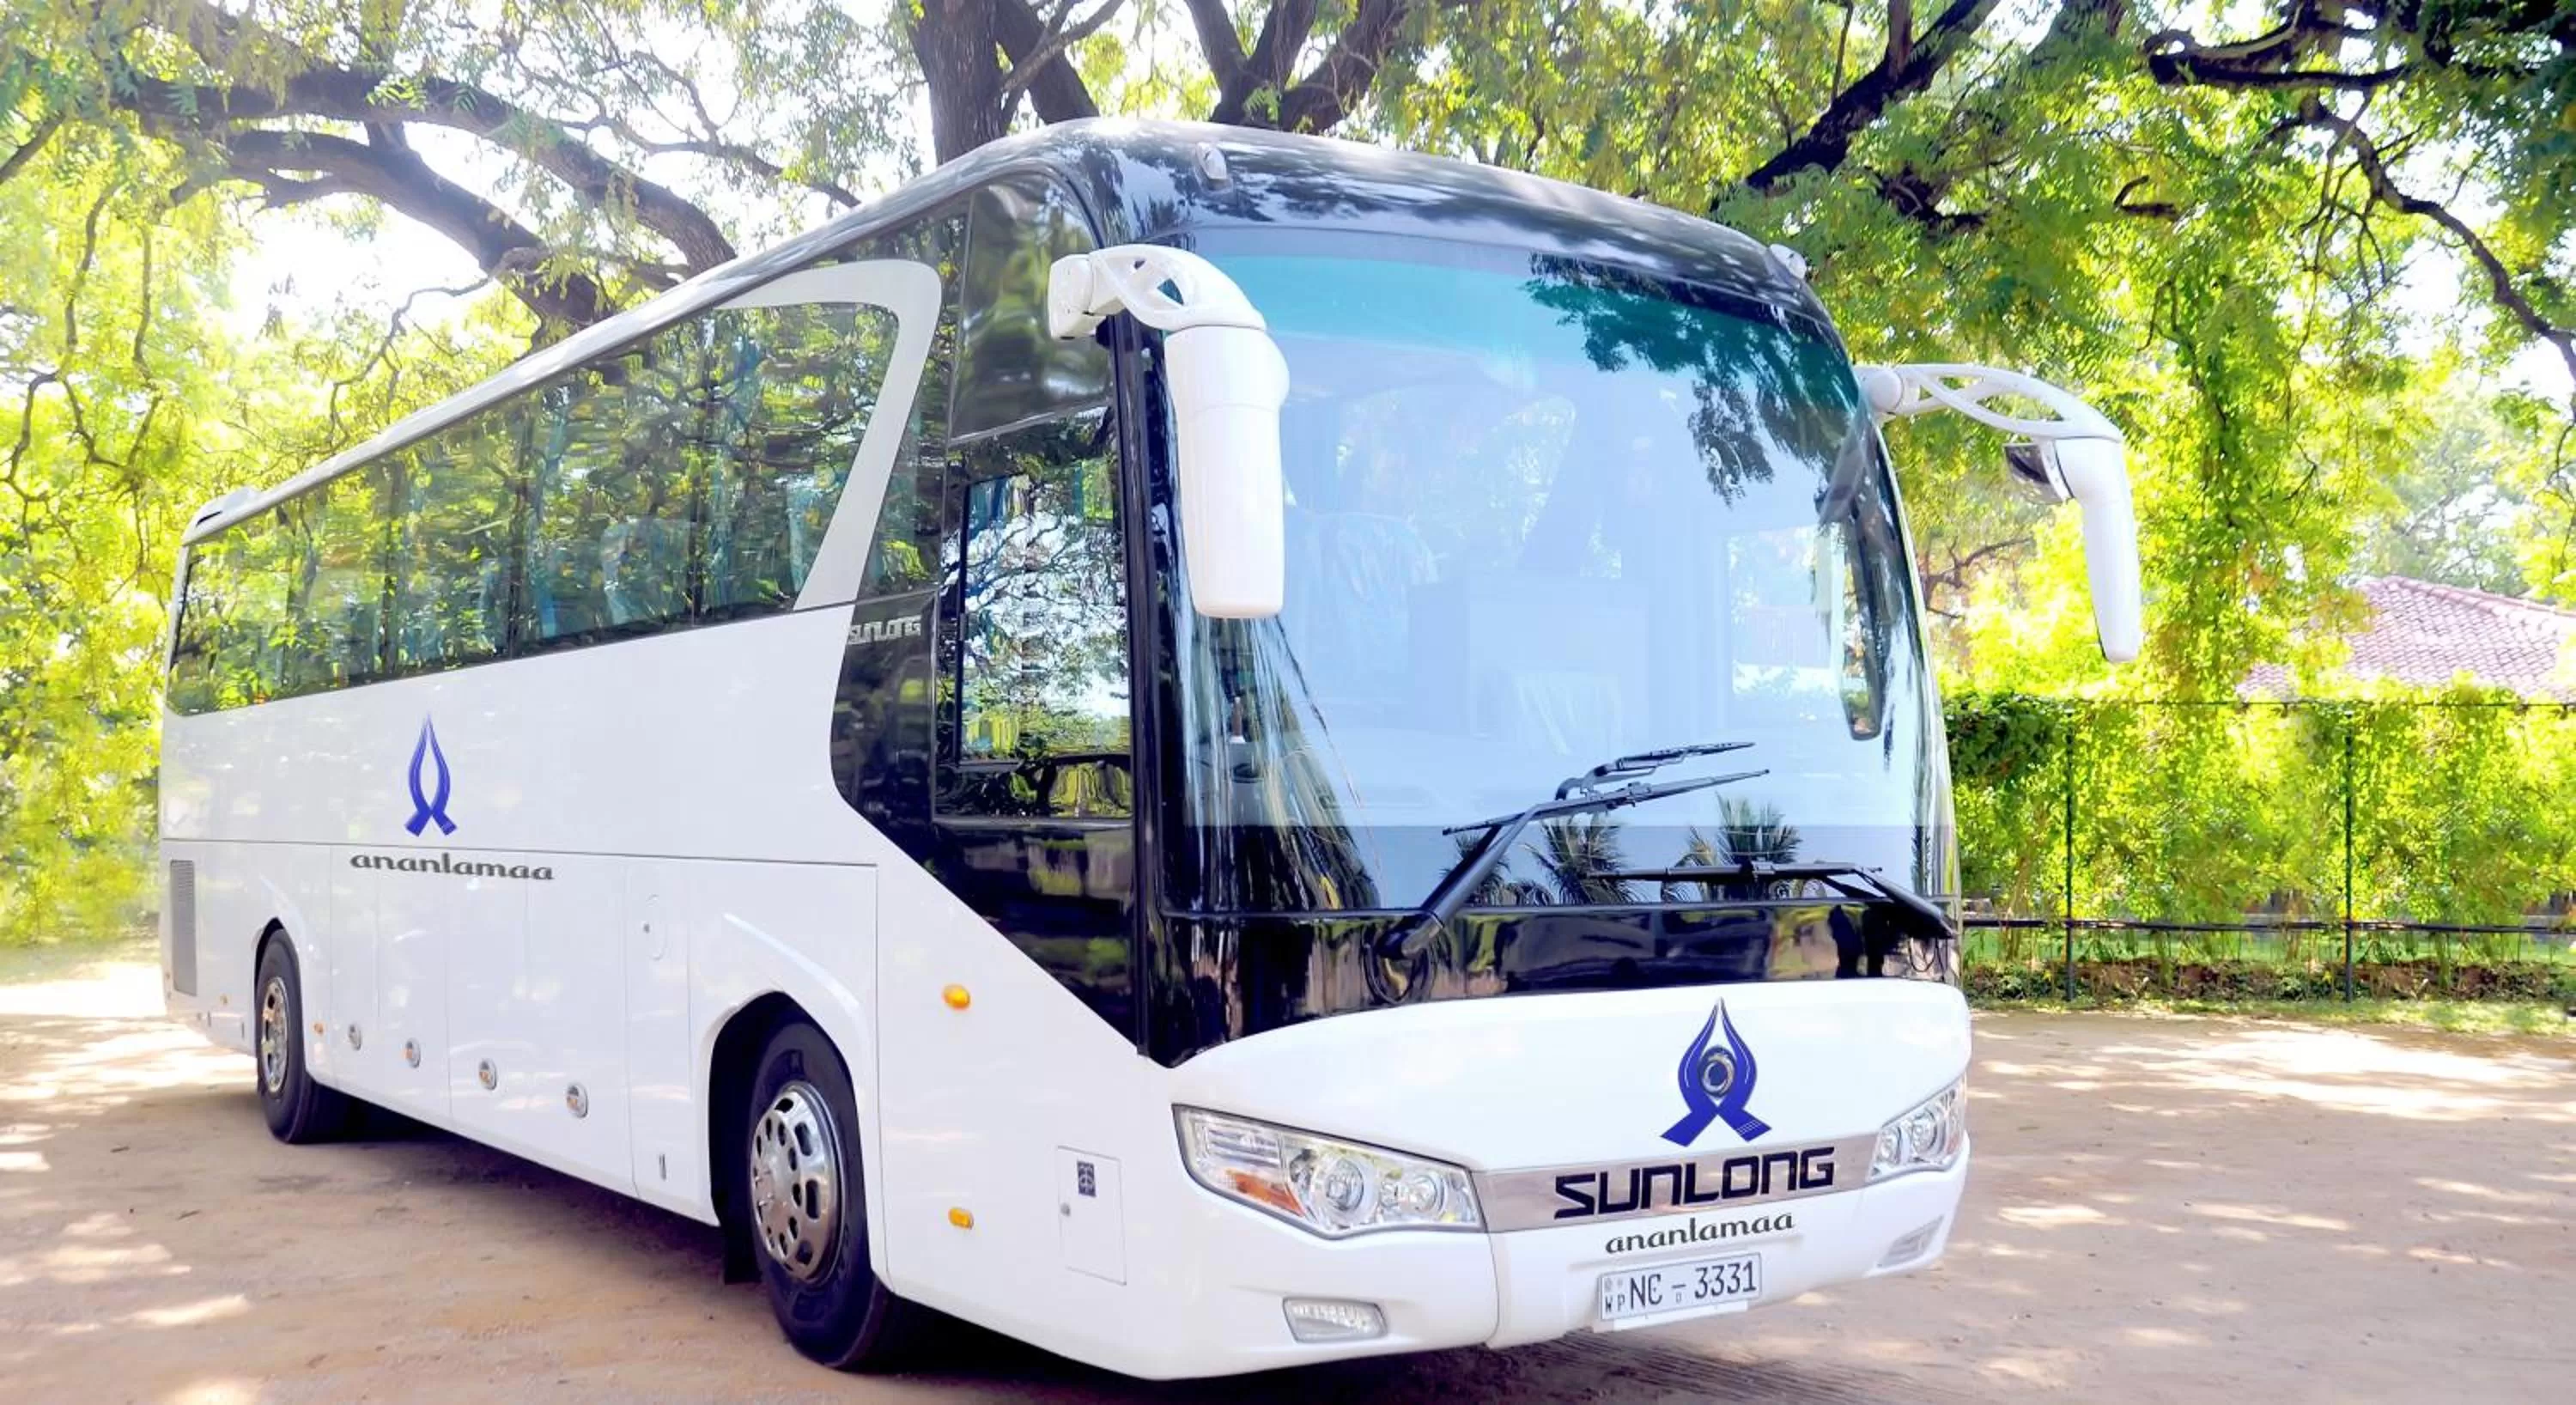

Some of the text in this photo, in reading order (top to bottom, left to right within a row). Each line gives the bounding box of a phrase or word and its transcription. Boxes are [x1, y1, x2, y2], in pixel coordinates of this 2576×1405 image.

[349, 852, 554, 880] ananlamaa
[1554, 1147, 1835, 1219] SUNLONG
[1605, 1212, 1796, 1254] ananlamaa
[1631, 1274, 1662, 1310] NC
[1694, 1260, 1757, 1299] 3331
